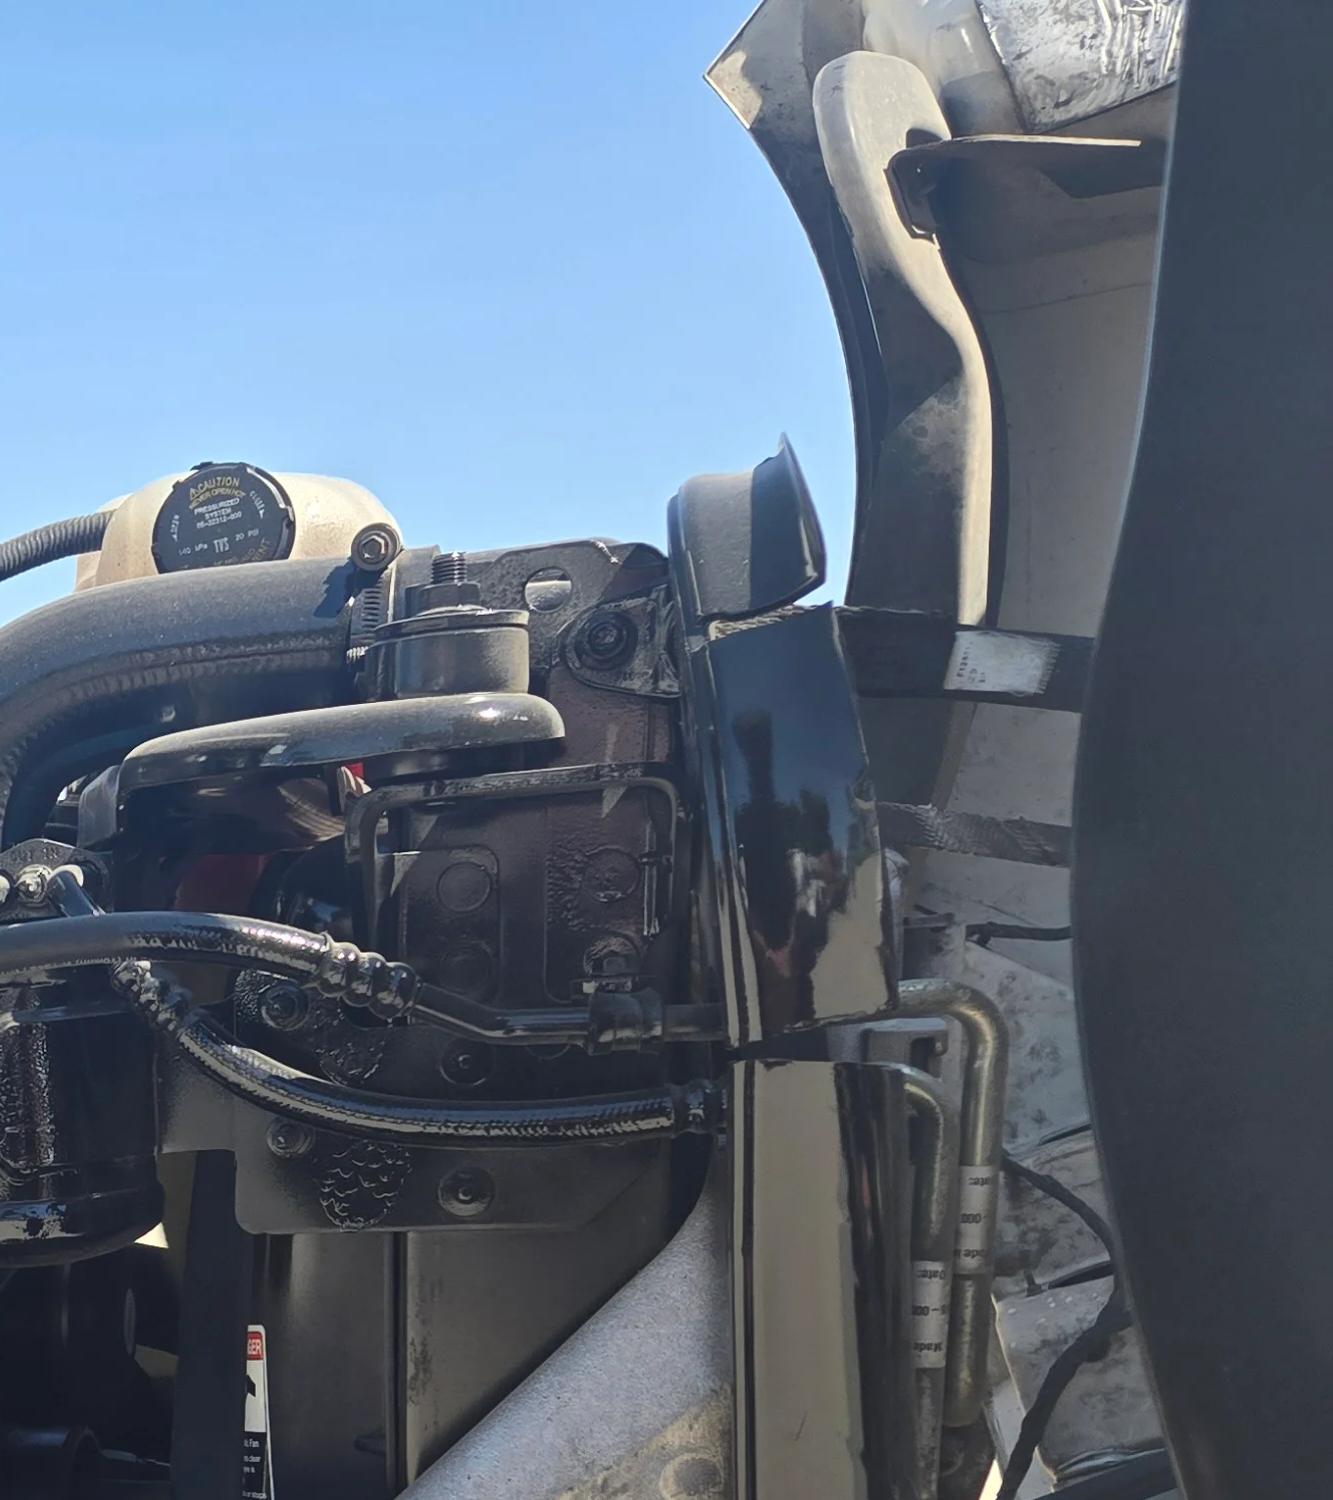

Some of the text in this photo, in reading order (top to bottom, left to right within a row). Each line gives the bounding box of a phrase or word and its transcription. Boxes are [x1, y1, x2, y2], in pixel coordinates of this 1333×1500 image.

[198, 476, 240, 493] CAUTION
[211, 487, 232, 497] OPEN
[233, 488, 247, 499] HOT
